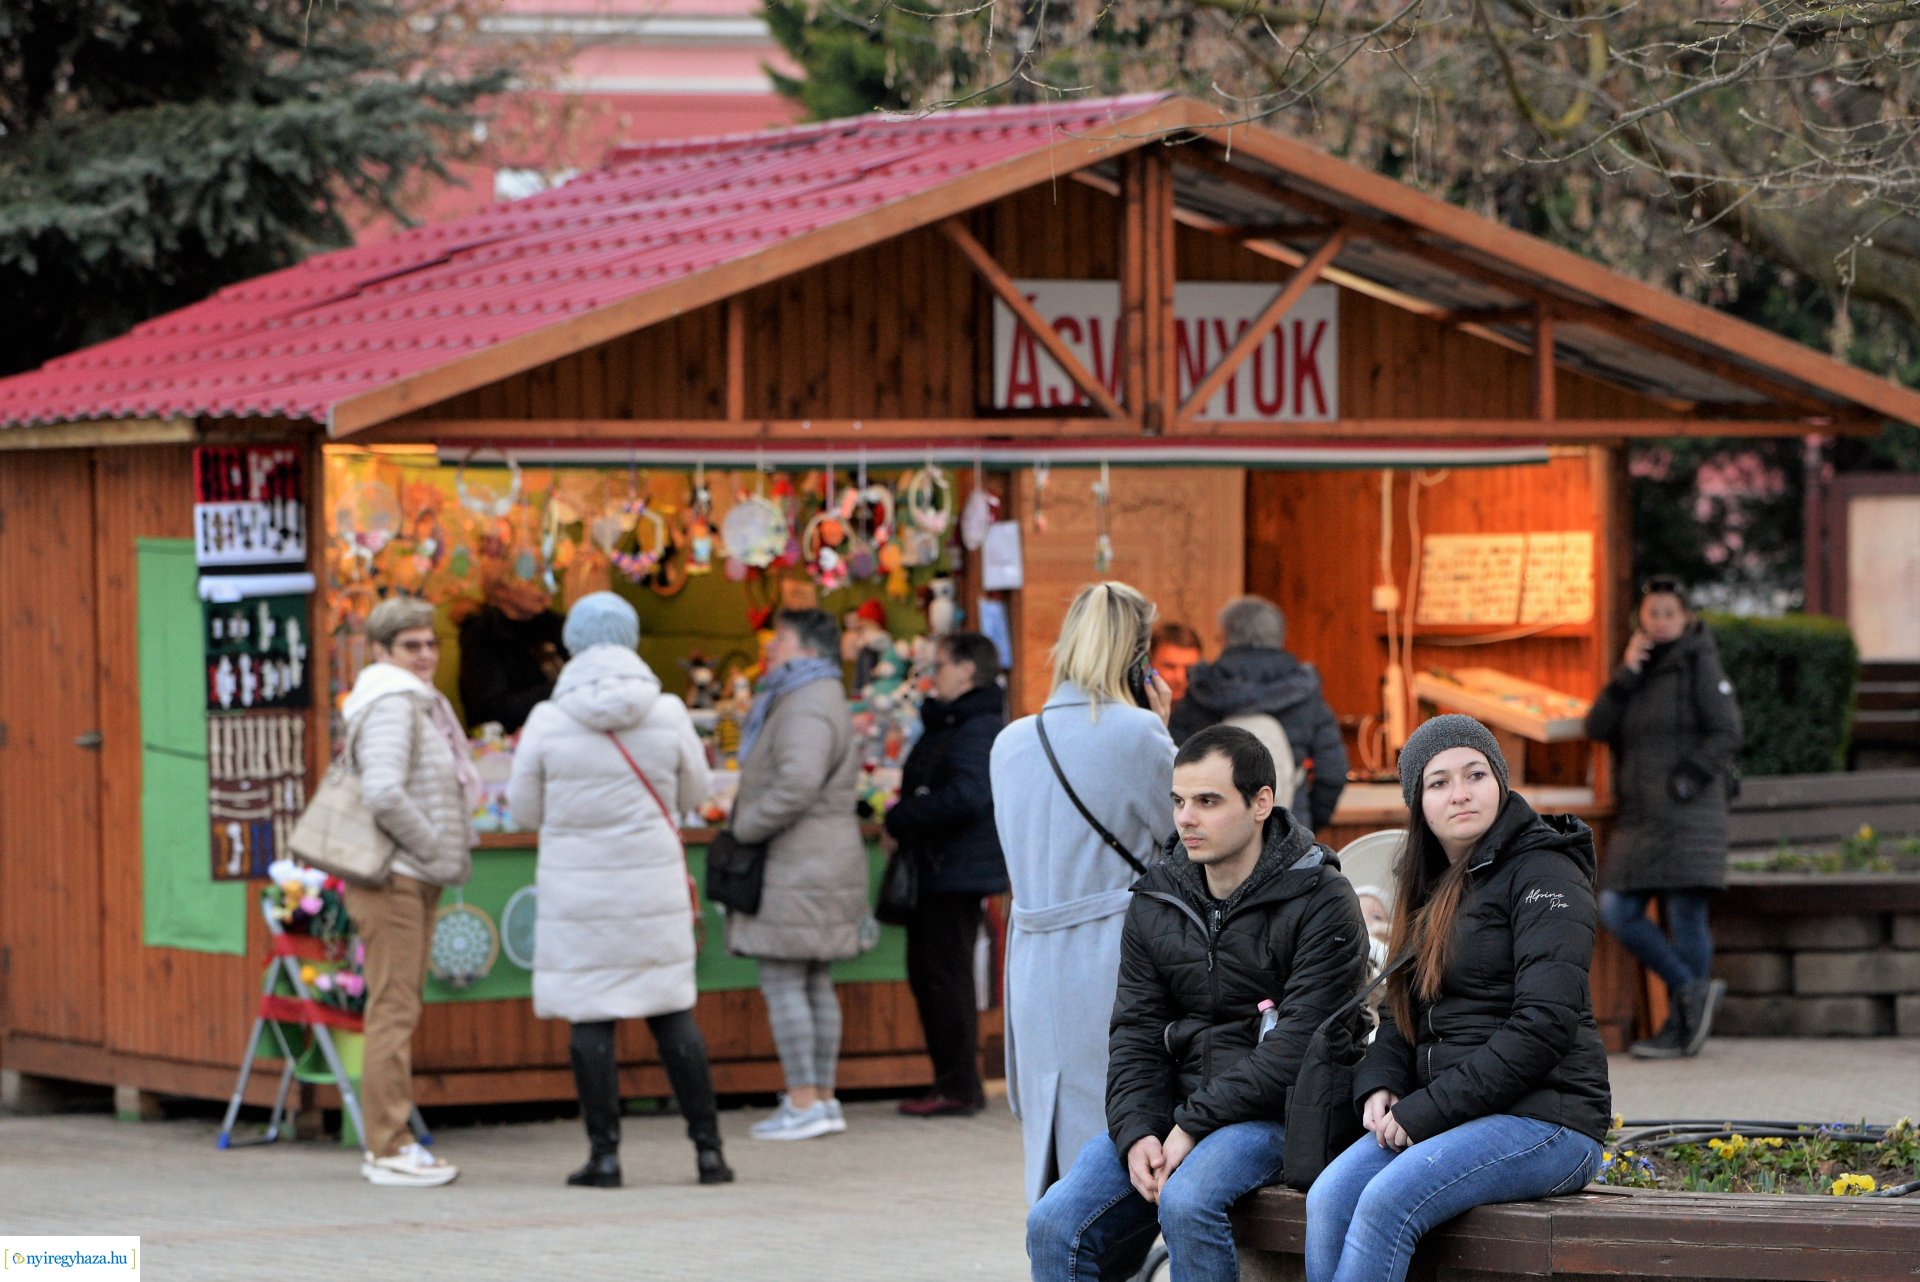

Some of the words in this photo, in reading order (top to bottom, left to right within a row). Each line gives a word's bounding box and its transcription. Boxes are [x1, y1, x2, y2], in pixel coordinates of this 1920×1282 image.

[1006, 293, 1327, 417] ÁSVNYOK
[1525, 888, 1564, 903] Alpine
[1550, 898, 1570, 911] Pro
